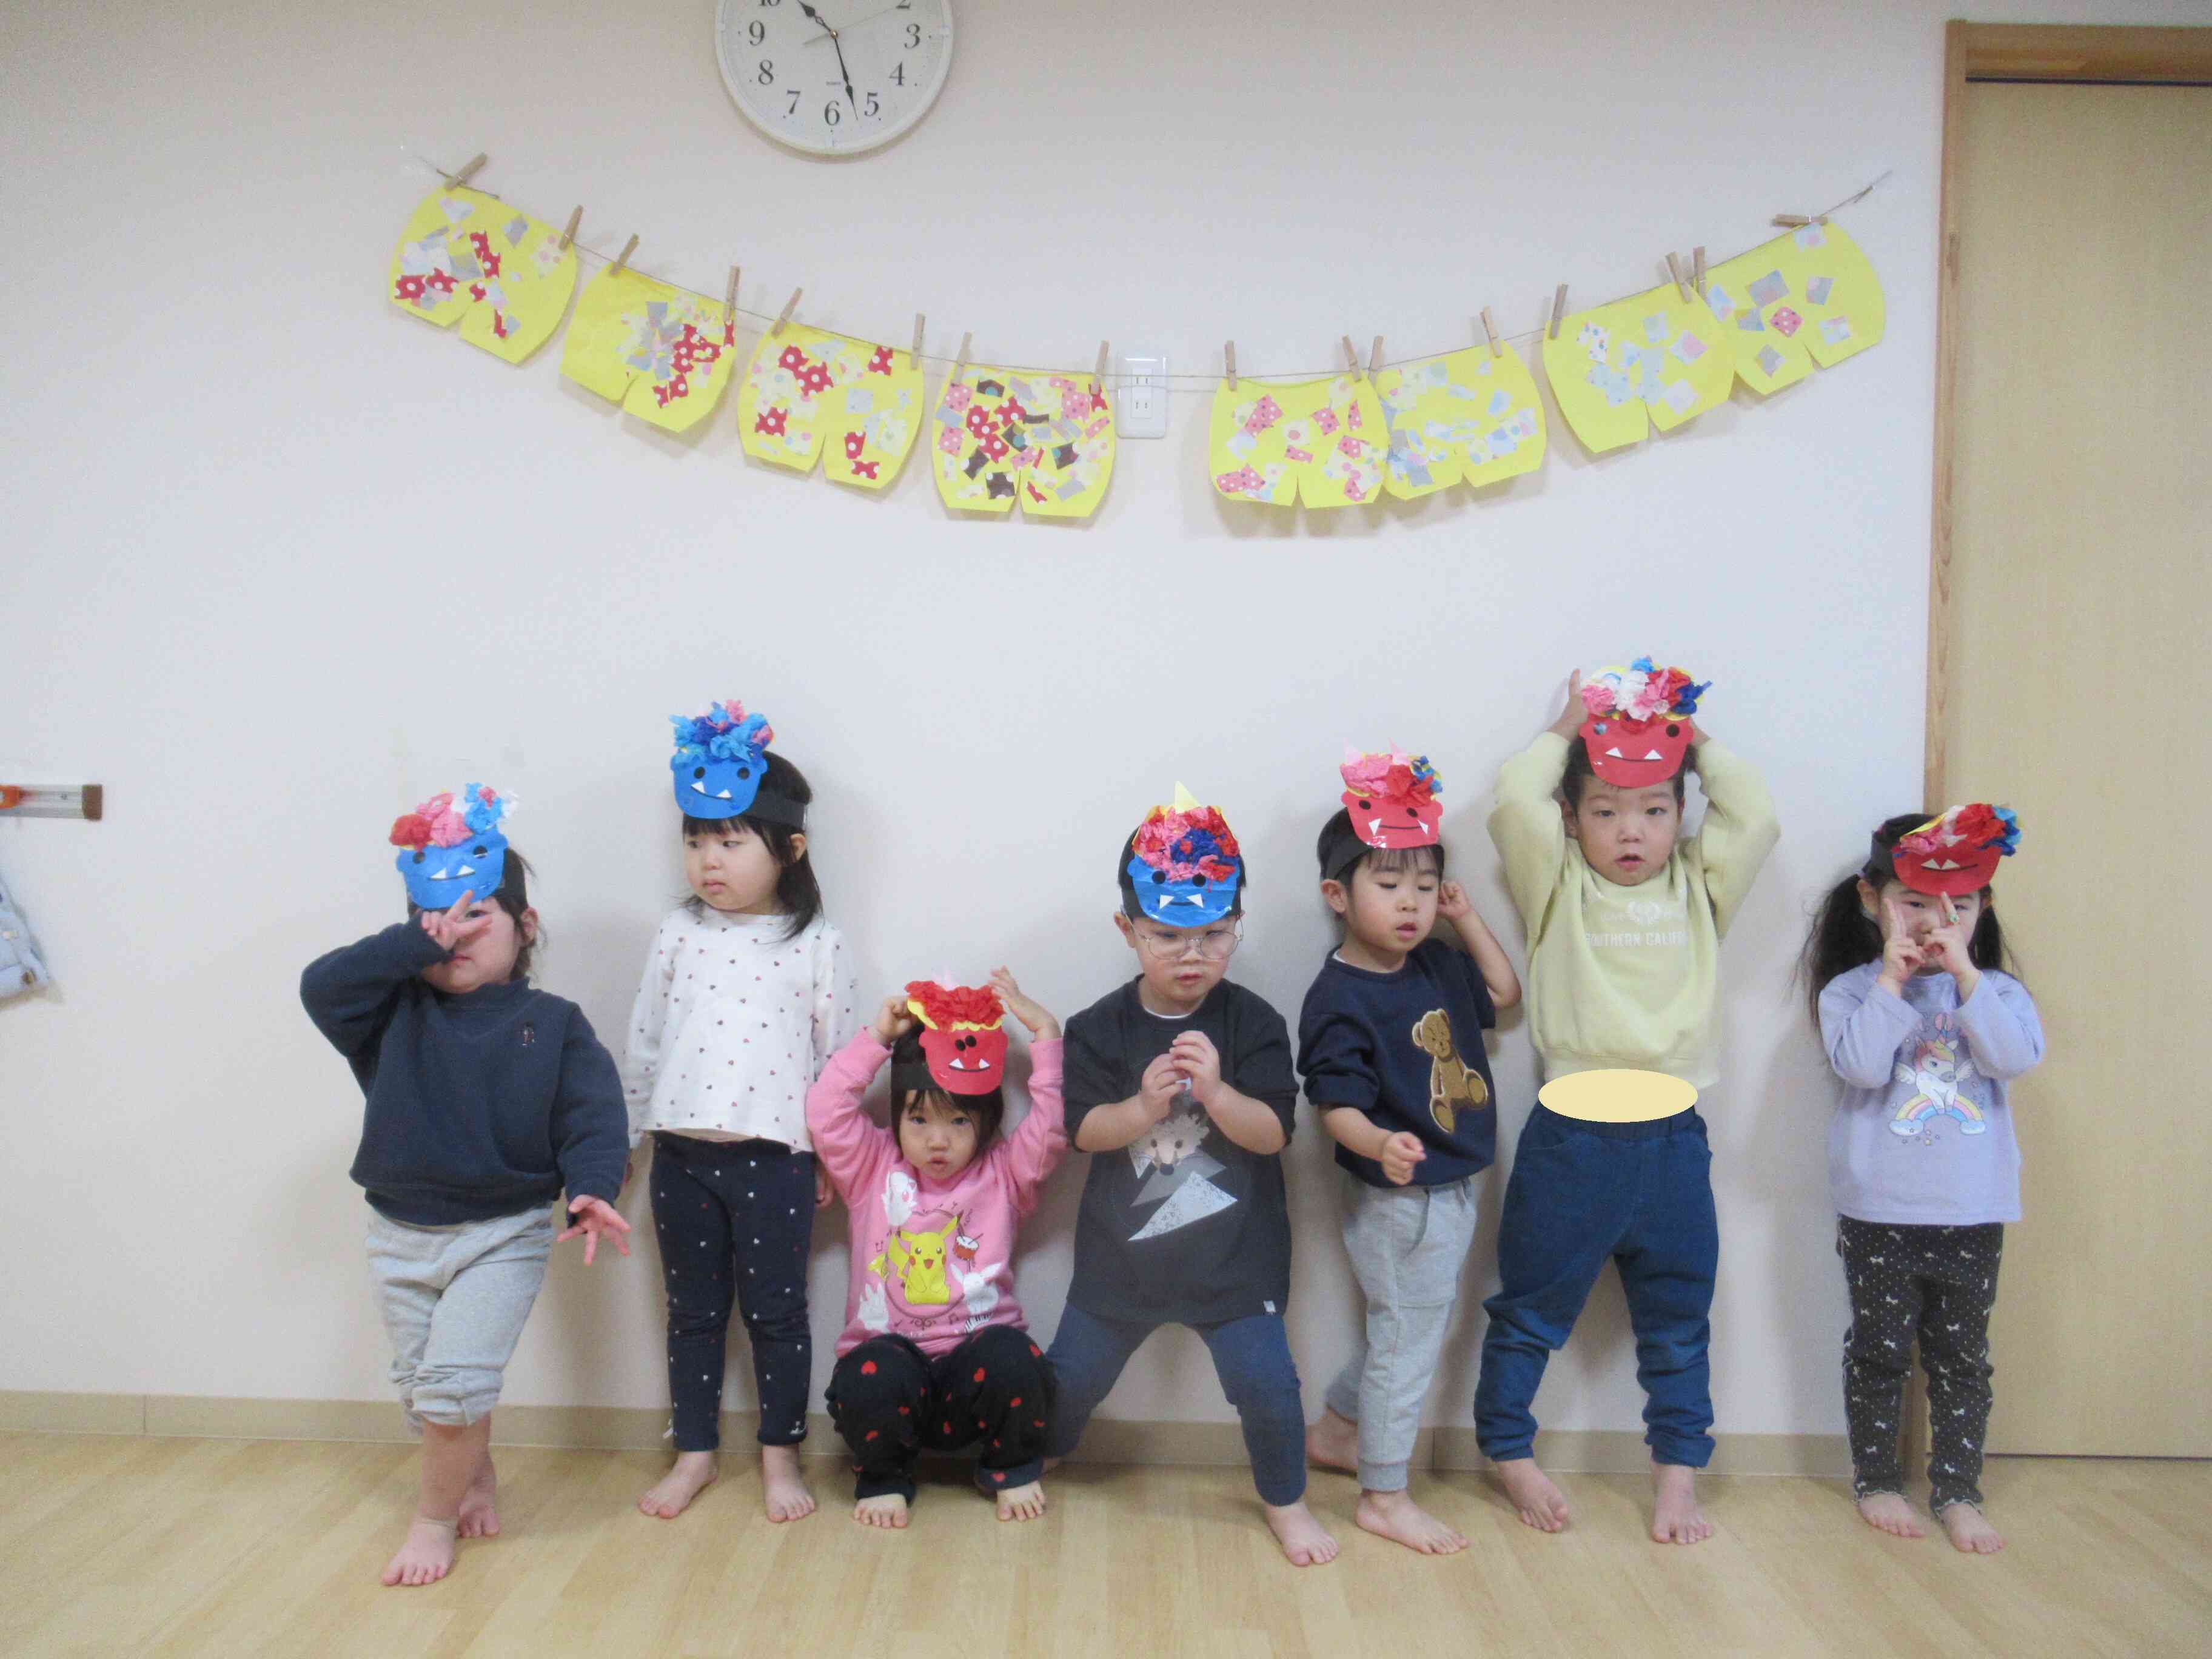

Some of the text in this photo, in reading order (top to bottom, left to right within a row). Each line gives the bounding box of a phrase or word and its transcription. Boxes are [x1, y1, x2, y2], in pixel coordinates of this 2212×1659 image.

[749, 21, 765, 45] 9
[905, 24, 920, 48] 3
[759, 60, 774, 85] 8
[890, 62, 904, 85] 4
[787, 90, 800, 114] 7
[825, 101, 840, 126] 6
[865, 92, 879, 116] 5
